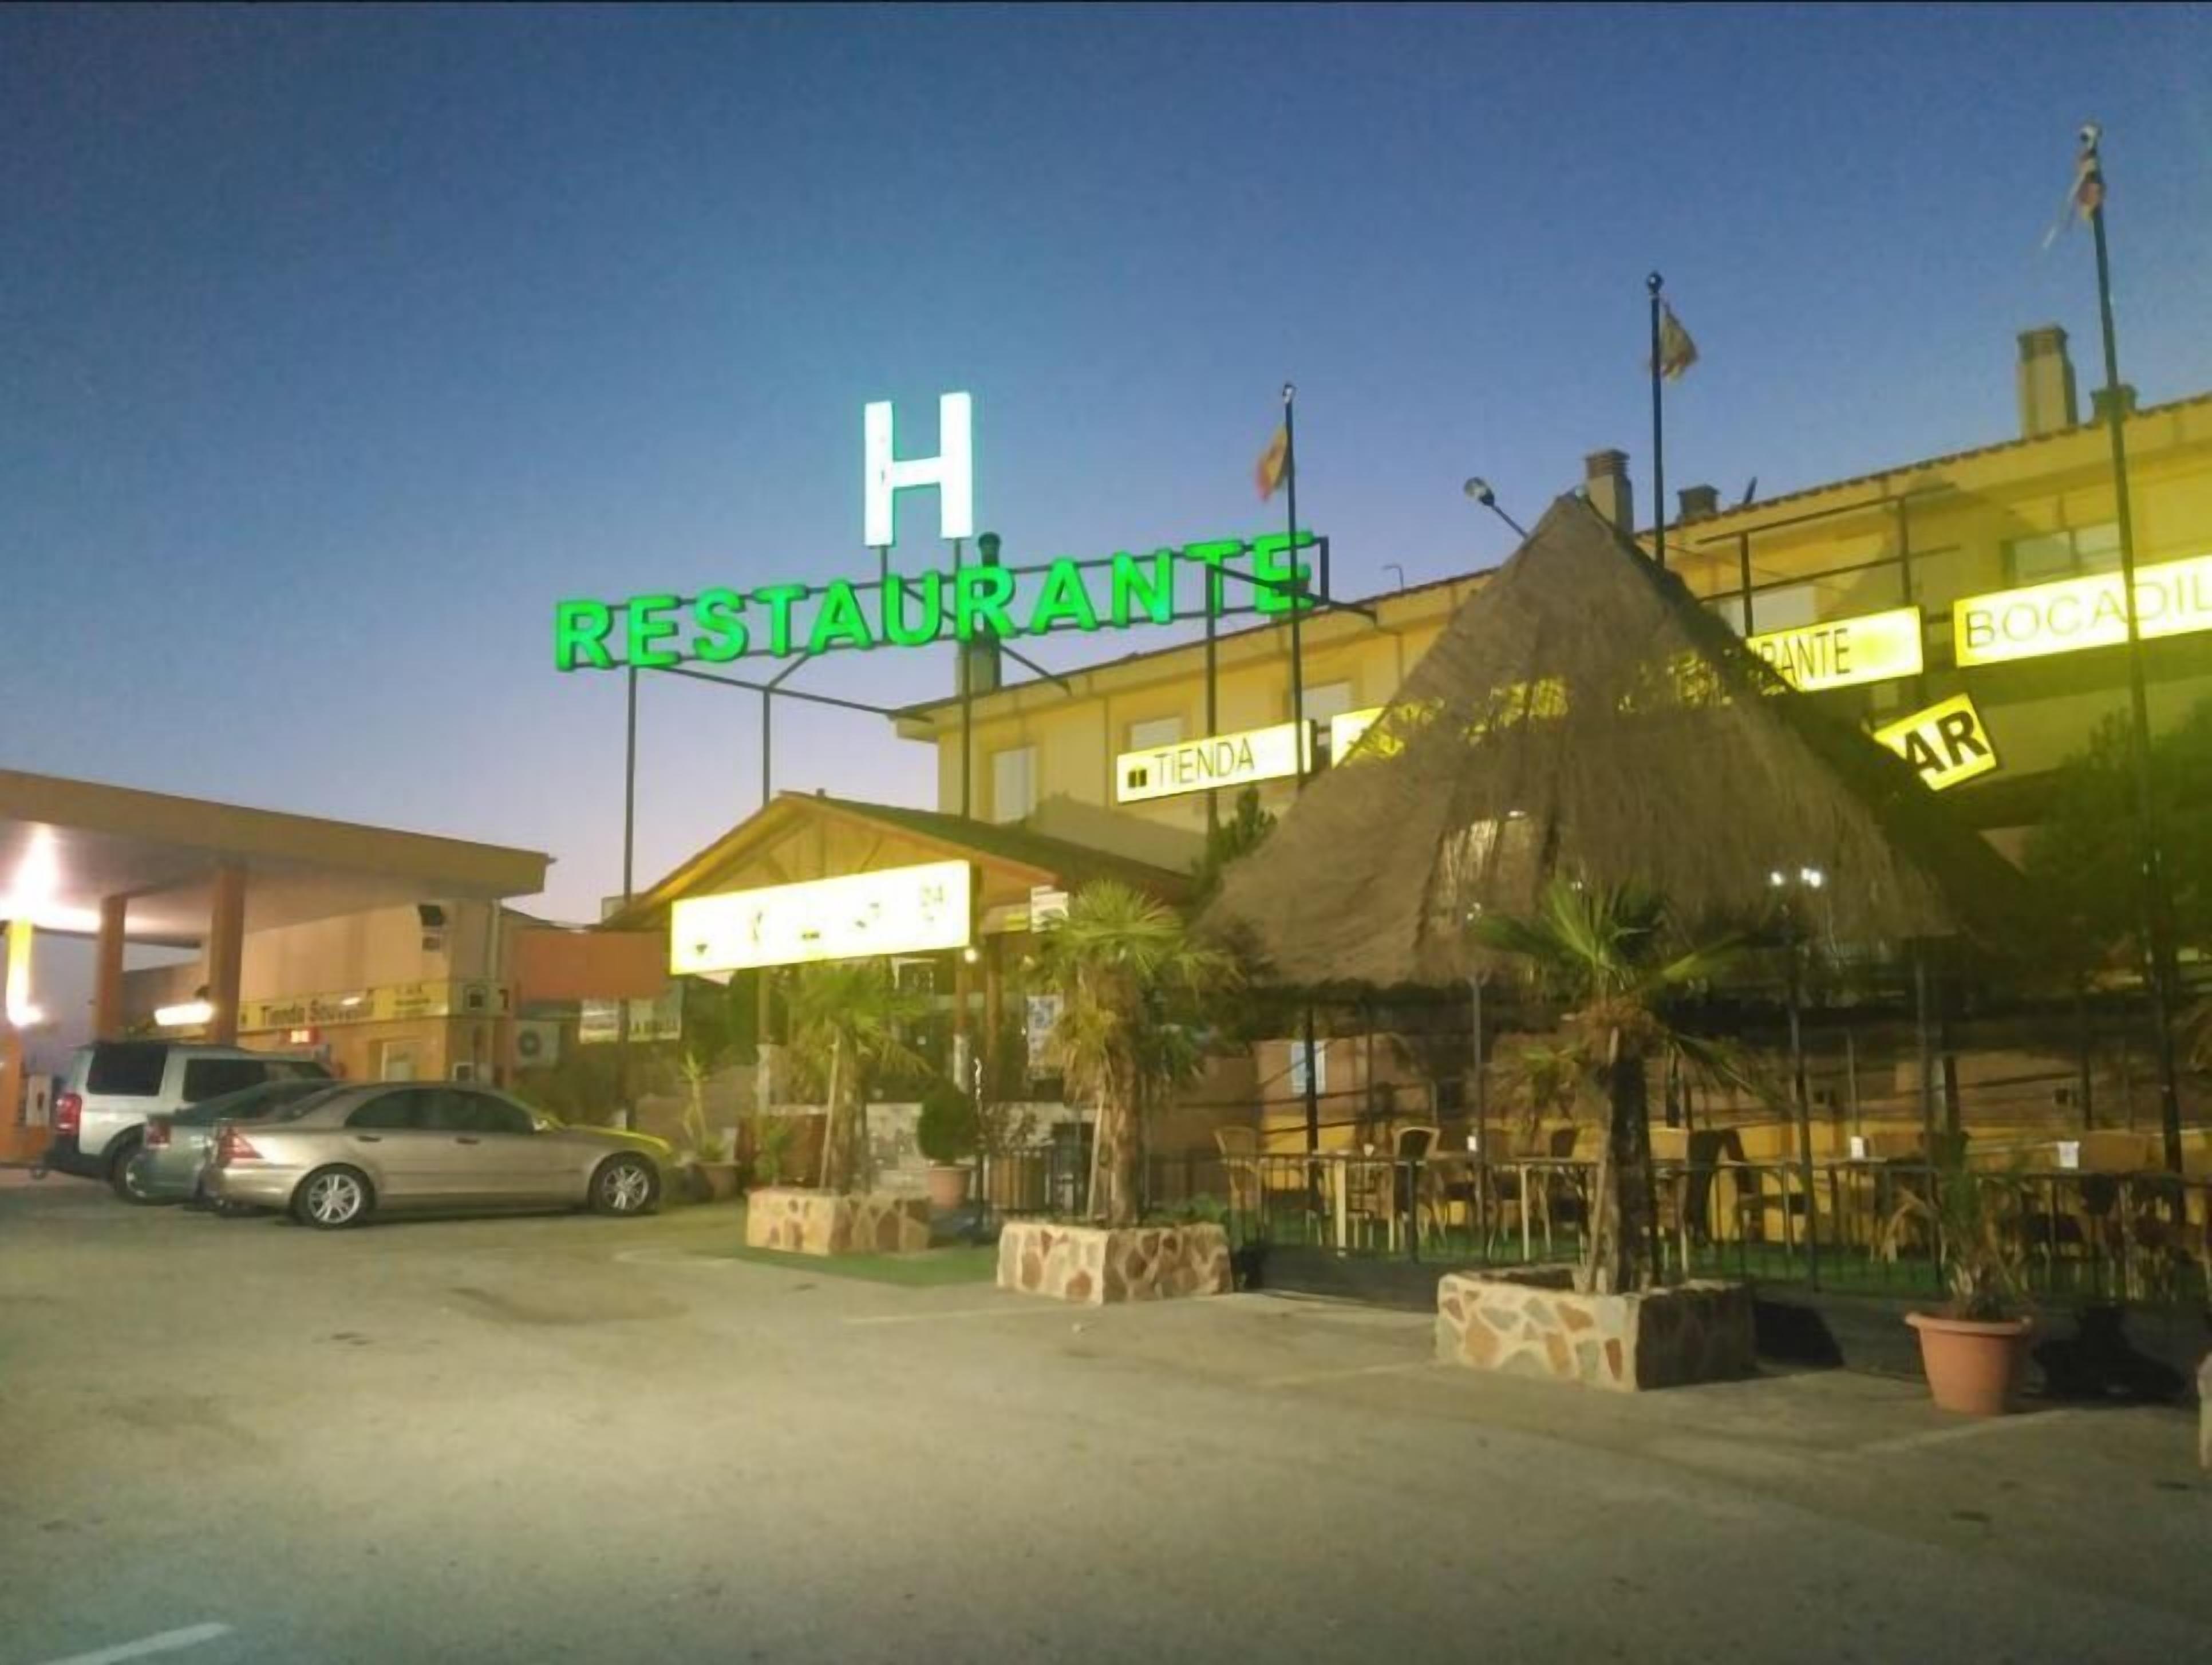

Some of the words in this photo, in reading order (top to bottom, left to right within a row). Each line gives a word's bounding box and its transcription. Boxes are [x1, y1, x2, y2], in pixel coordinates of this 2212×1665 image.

[864, 392, 973, 546] H
[555, 530, 1316, 672] RESTAURANTE
[1154, 737, 1255, 788] TIENDA
